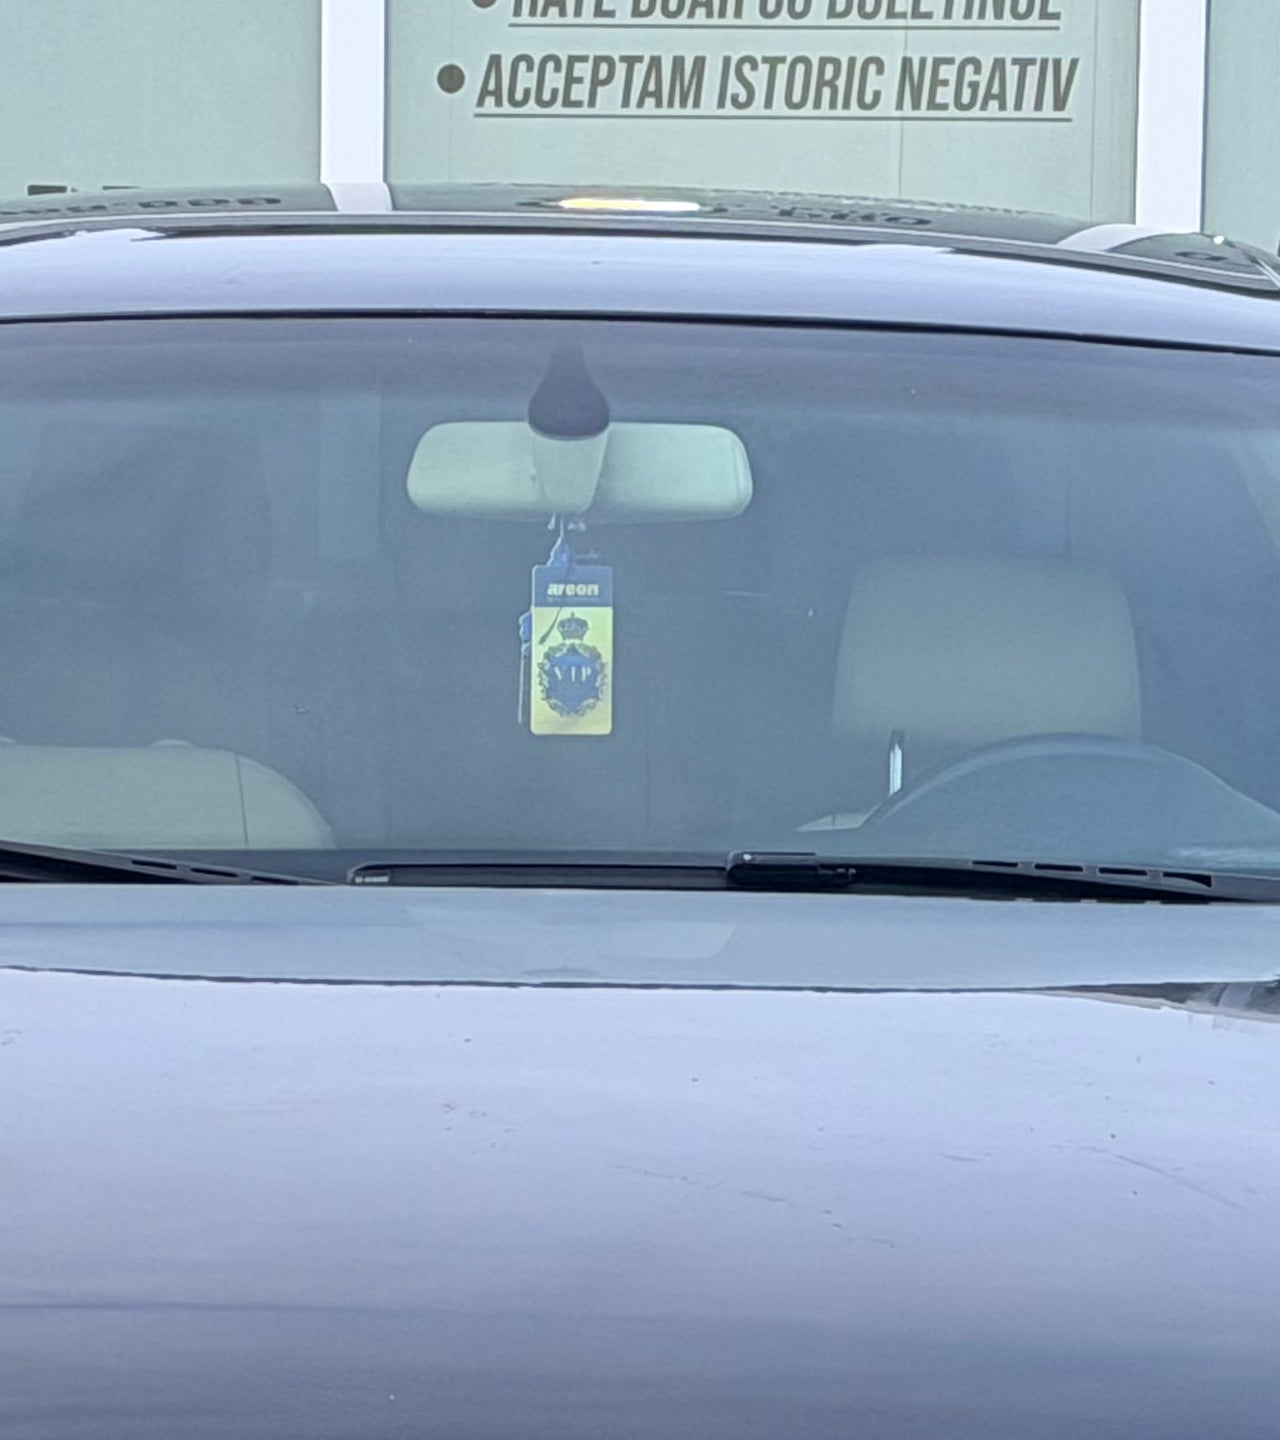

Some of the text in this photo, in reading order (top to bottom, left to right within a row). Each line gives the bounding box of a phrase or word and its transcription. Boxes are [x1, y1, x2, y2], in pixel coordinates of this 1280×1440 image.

[475, 53, 1080, 112] ACCEPTAM ISTORIC NEGATIV
[554, 665, 592, 682] VIP
